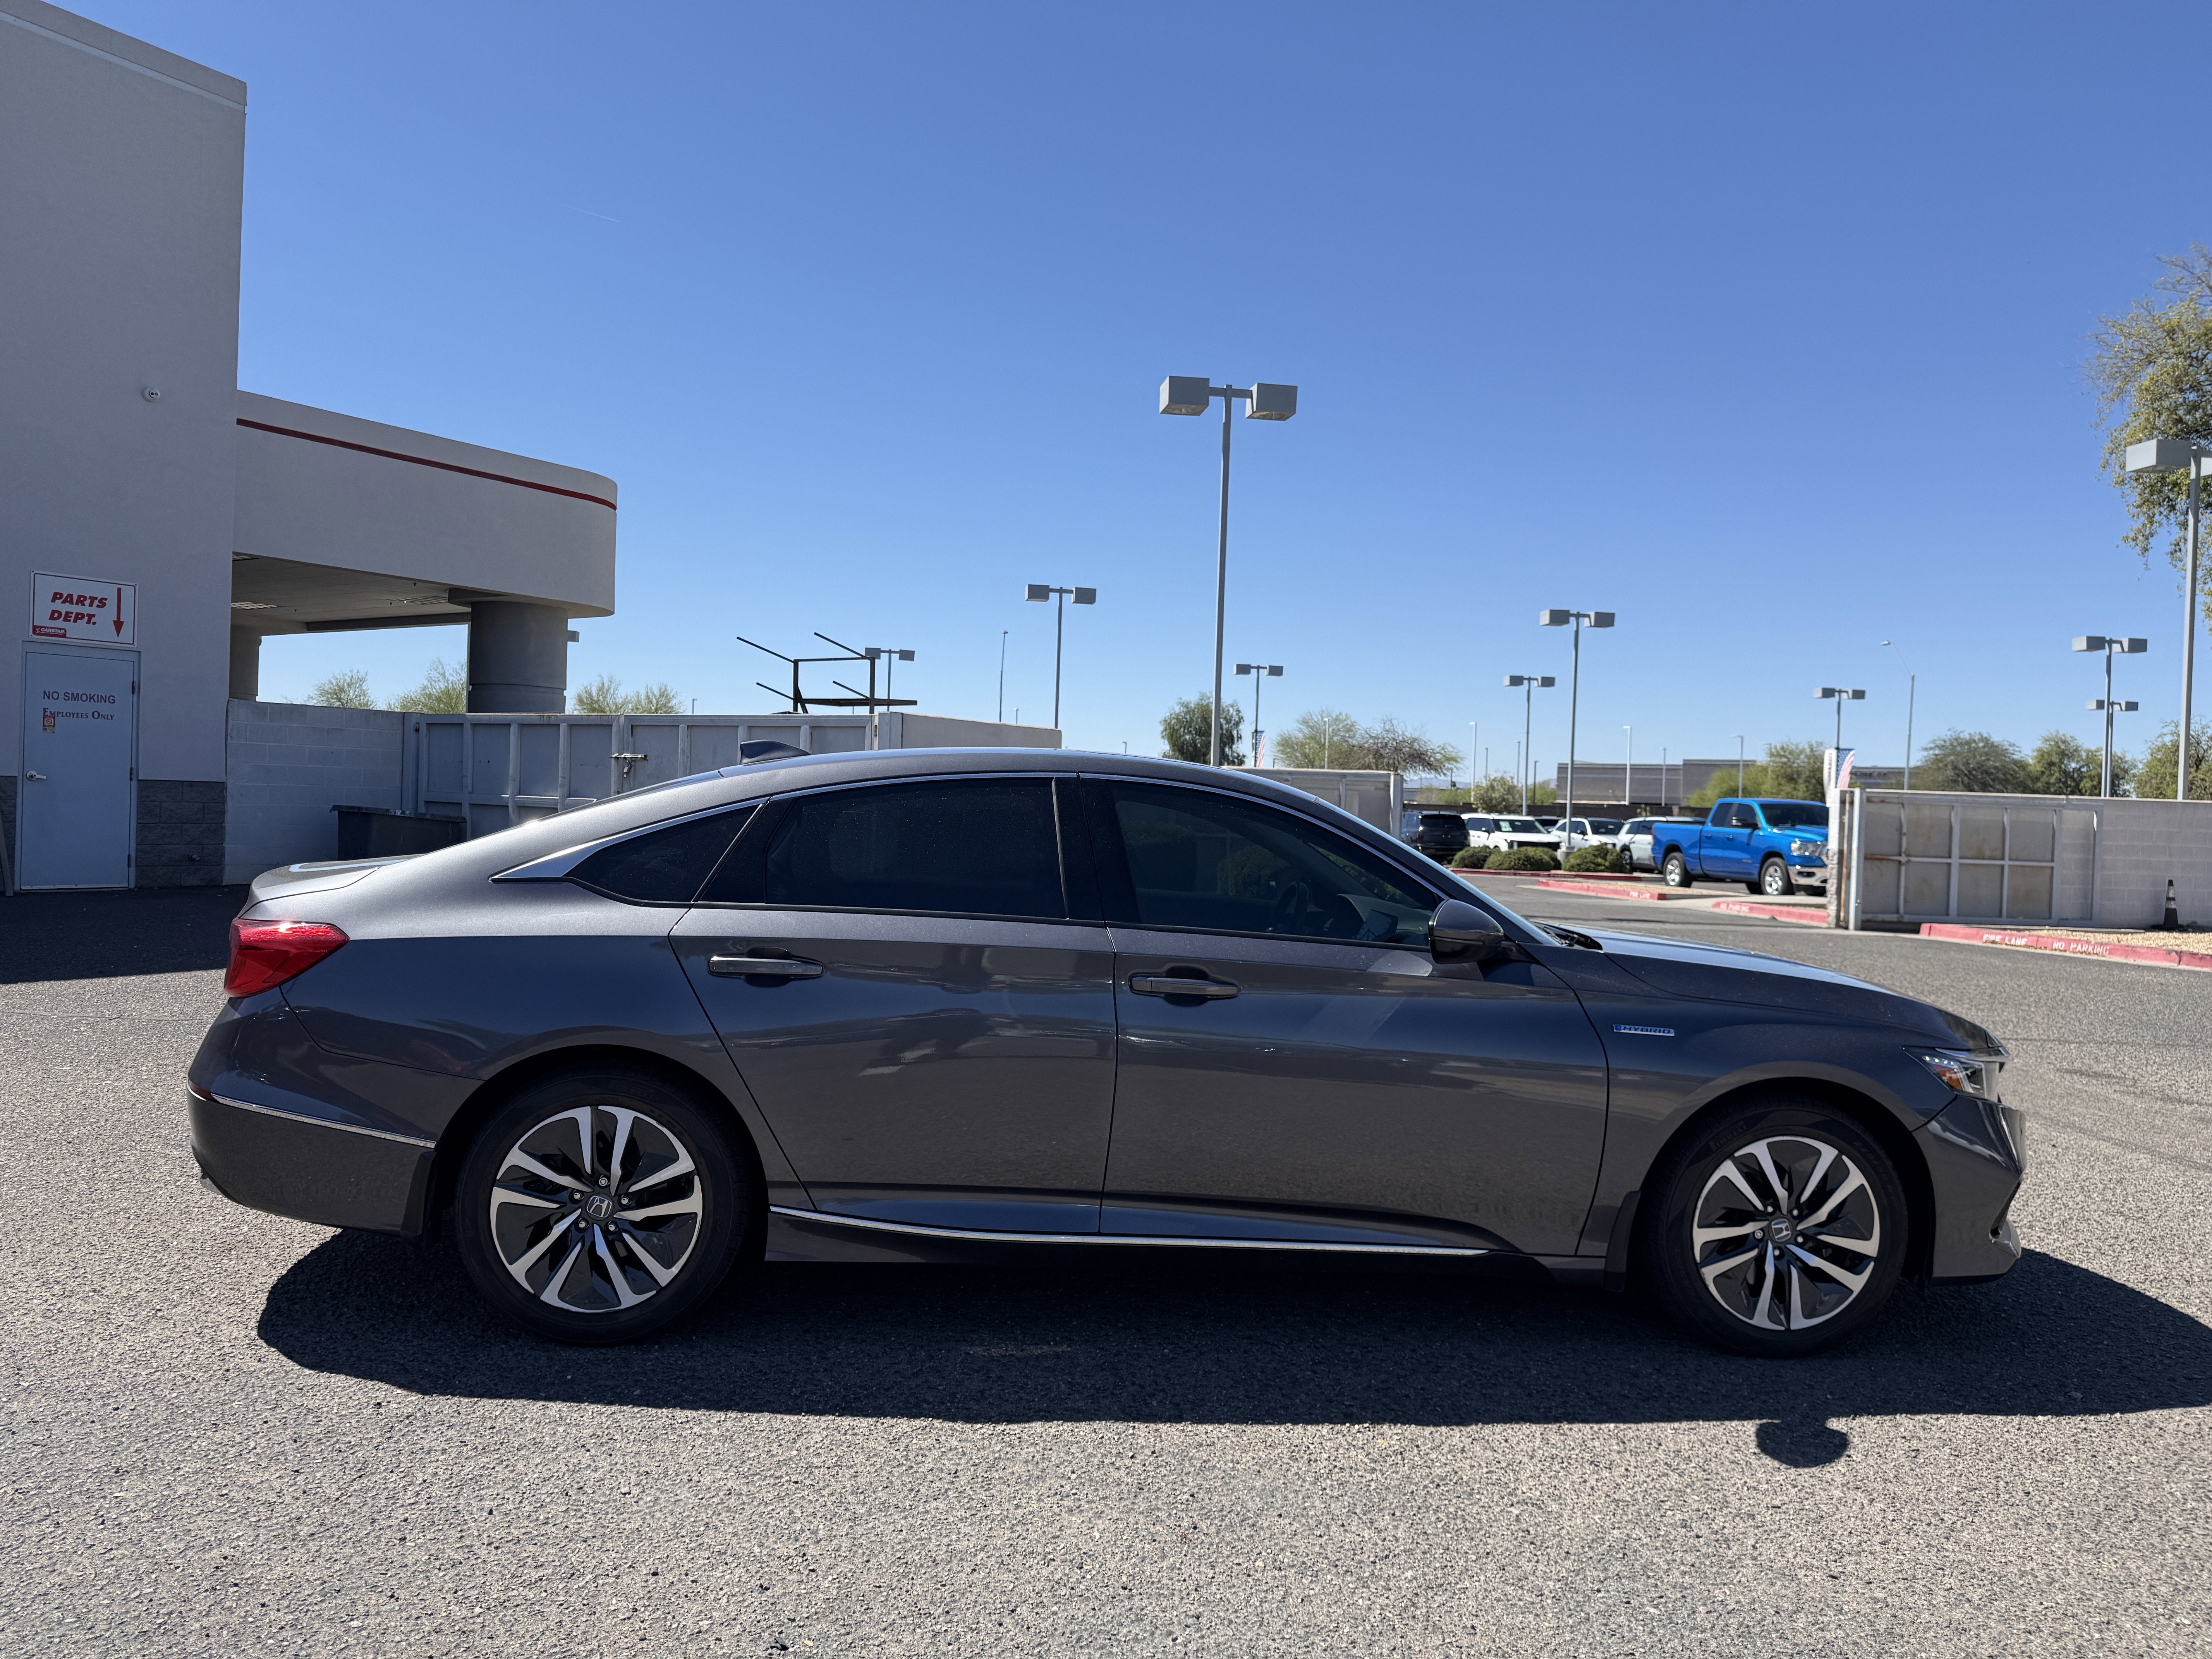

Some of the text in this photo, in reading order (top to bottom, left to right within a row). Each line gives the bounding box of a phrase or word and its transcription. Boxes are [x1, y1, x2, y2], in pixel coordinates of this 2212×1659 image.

[51, 592, 108, 608] PARTS
[49, 610, 96, 625] DEPT.
[43, 690, 115, 704] NO SMOKING
[43, 708, 114, 720] EMPLOYEES ONLY
[2052, 941, 2109, 955] NO PARKING
